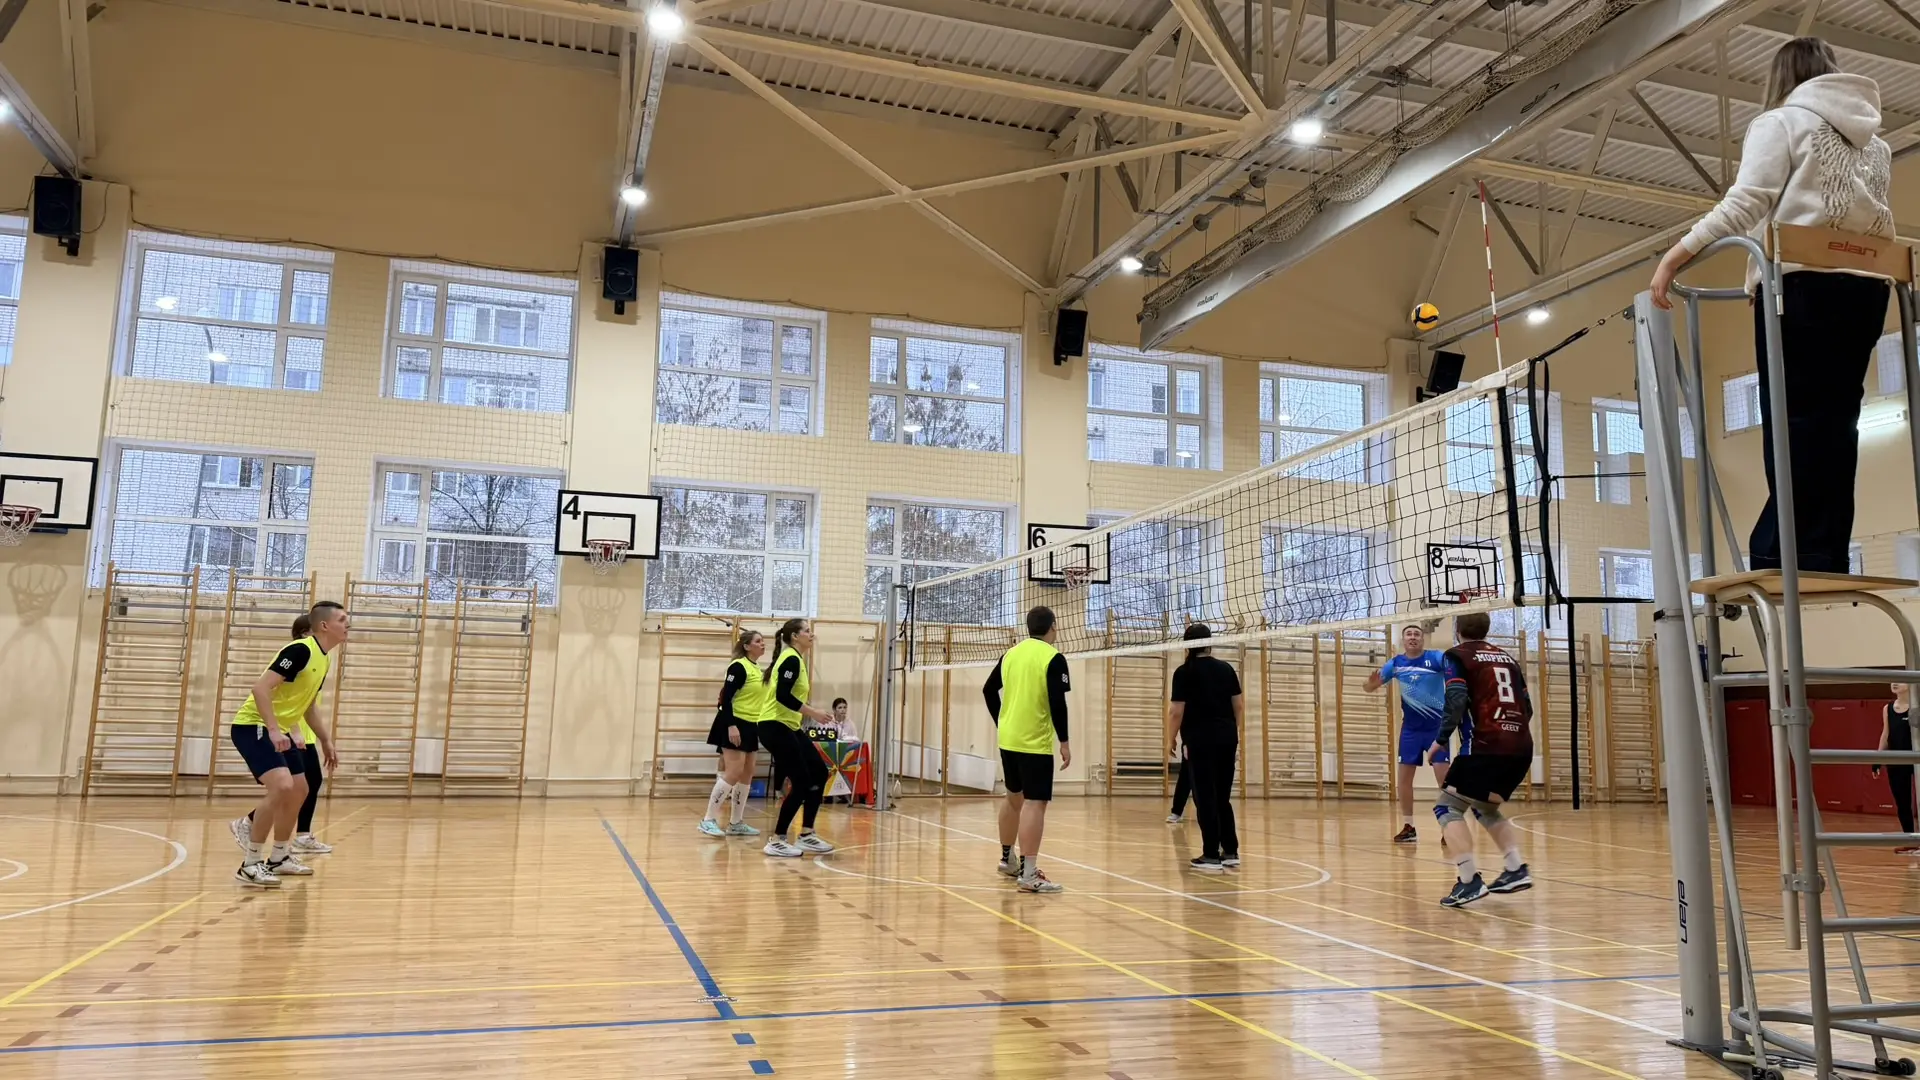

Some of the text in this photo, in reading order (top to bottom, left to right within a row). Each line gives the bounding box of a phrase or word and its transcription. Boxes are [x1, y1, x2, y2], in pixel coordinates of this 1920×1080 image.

[1828, 240, 1878, 258] elan
[562, 495, 581, 520] 4
[1032, 528, 1046, 548] 6
[1431, 547, 1444, 568] 8
[279, 658, 293, 670] 88
[1493, 666, 1516, 703] 8
[809, 729, 817, 738] 6
[828, 731, 835, 739] 5
[1677, 879, 1689, 944] elan
